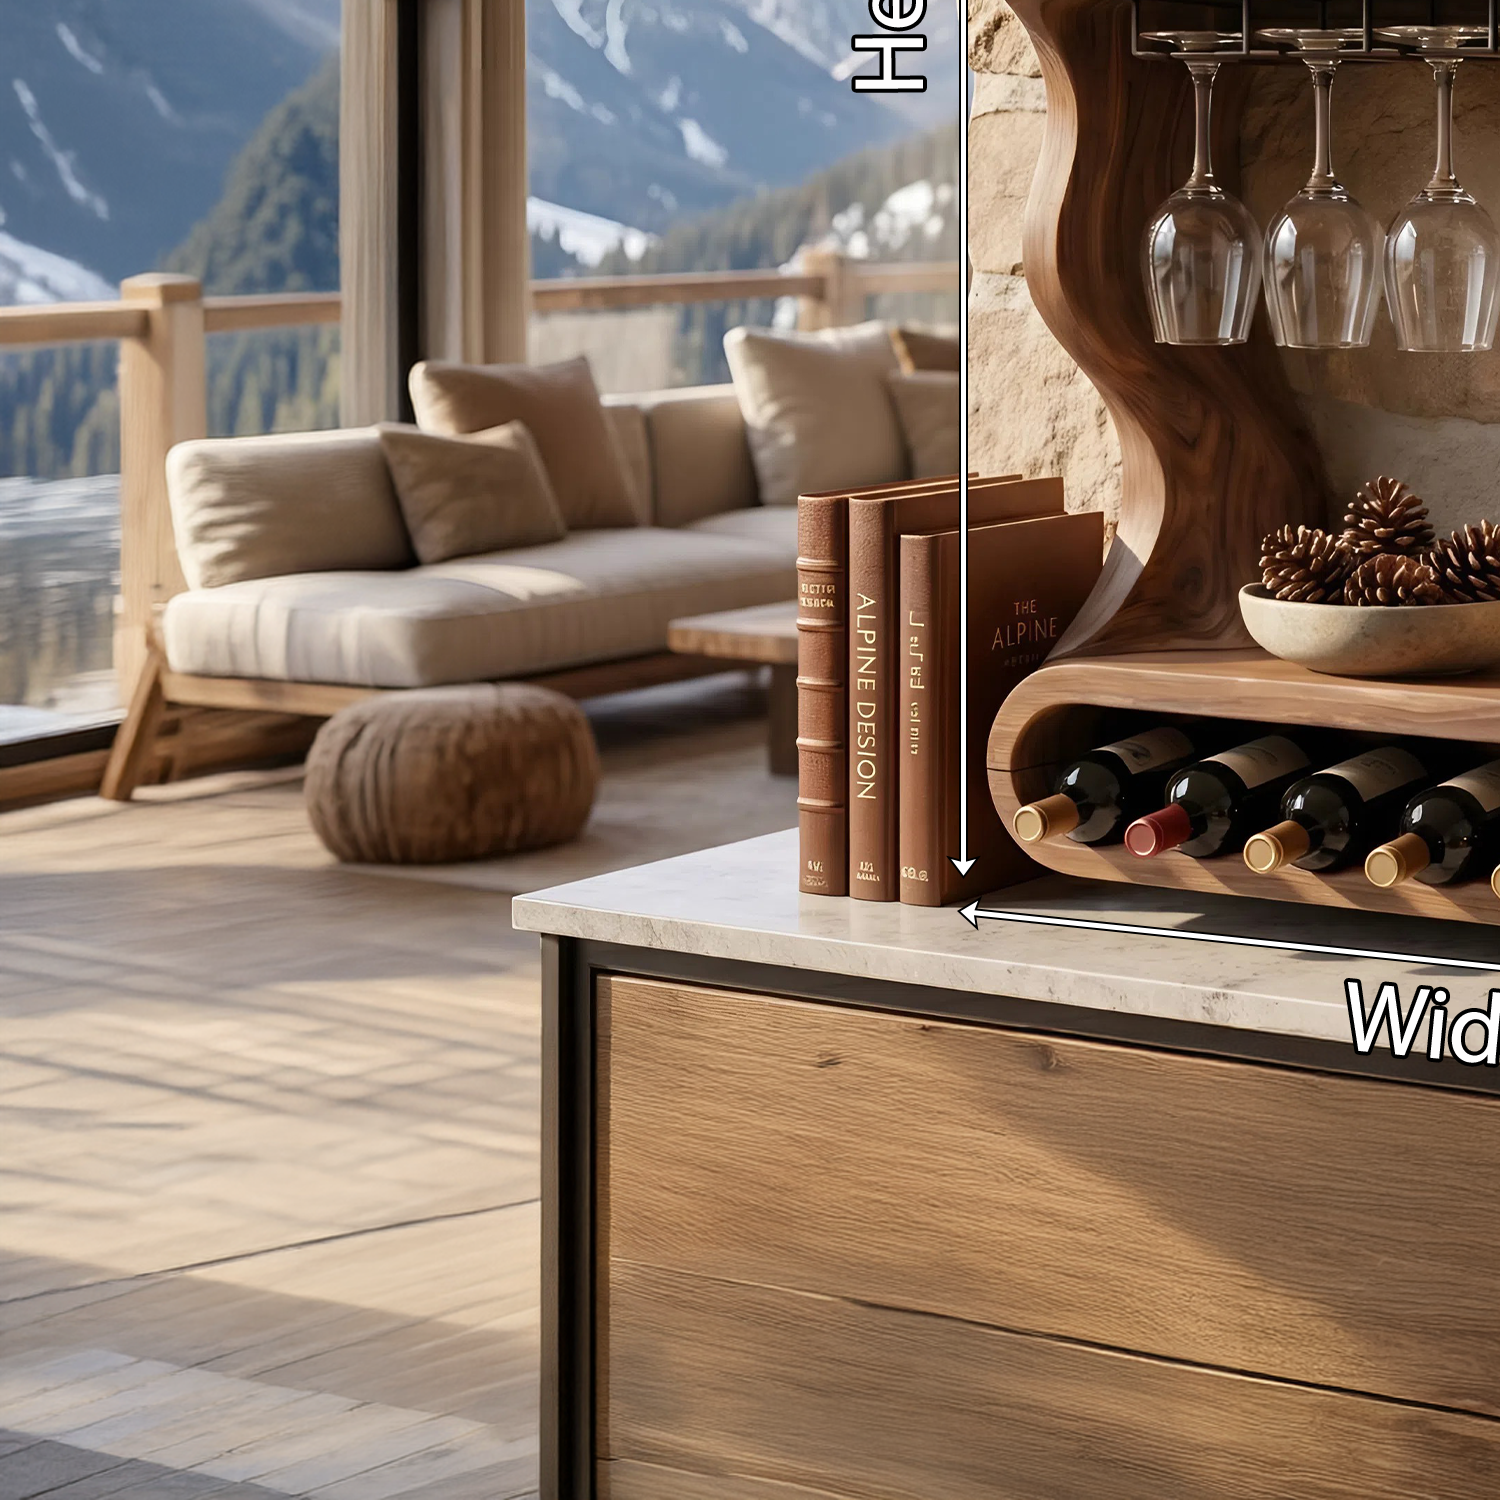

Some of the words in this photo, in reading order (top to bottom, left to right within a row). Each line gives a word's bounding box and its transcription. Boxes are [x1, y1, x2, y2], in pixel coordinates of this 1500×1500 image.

[991, 616, 1058, 651] ALPINE
[1013, 599, 1037, 616] THE
[856, 592, 877, 691] ALPINE
[856, 701, 877, 800] DESION
